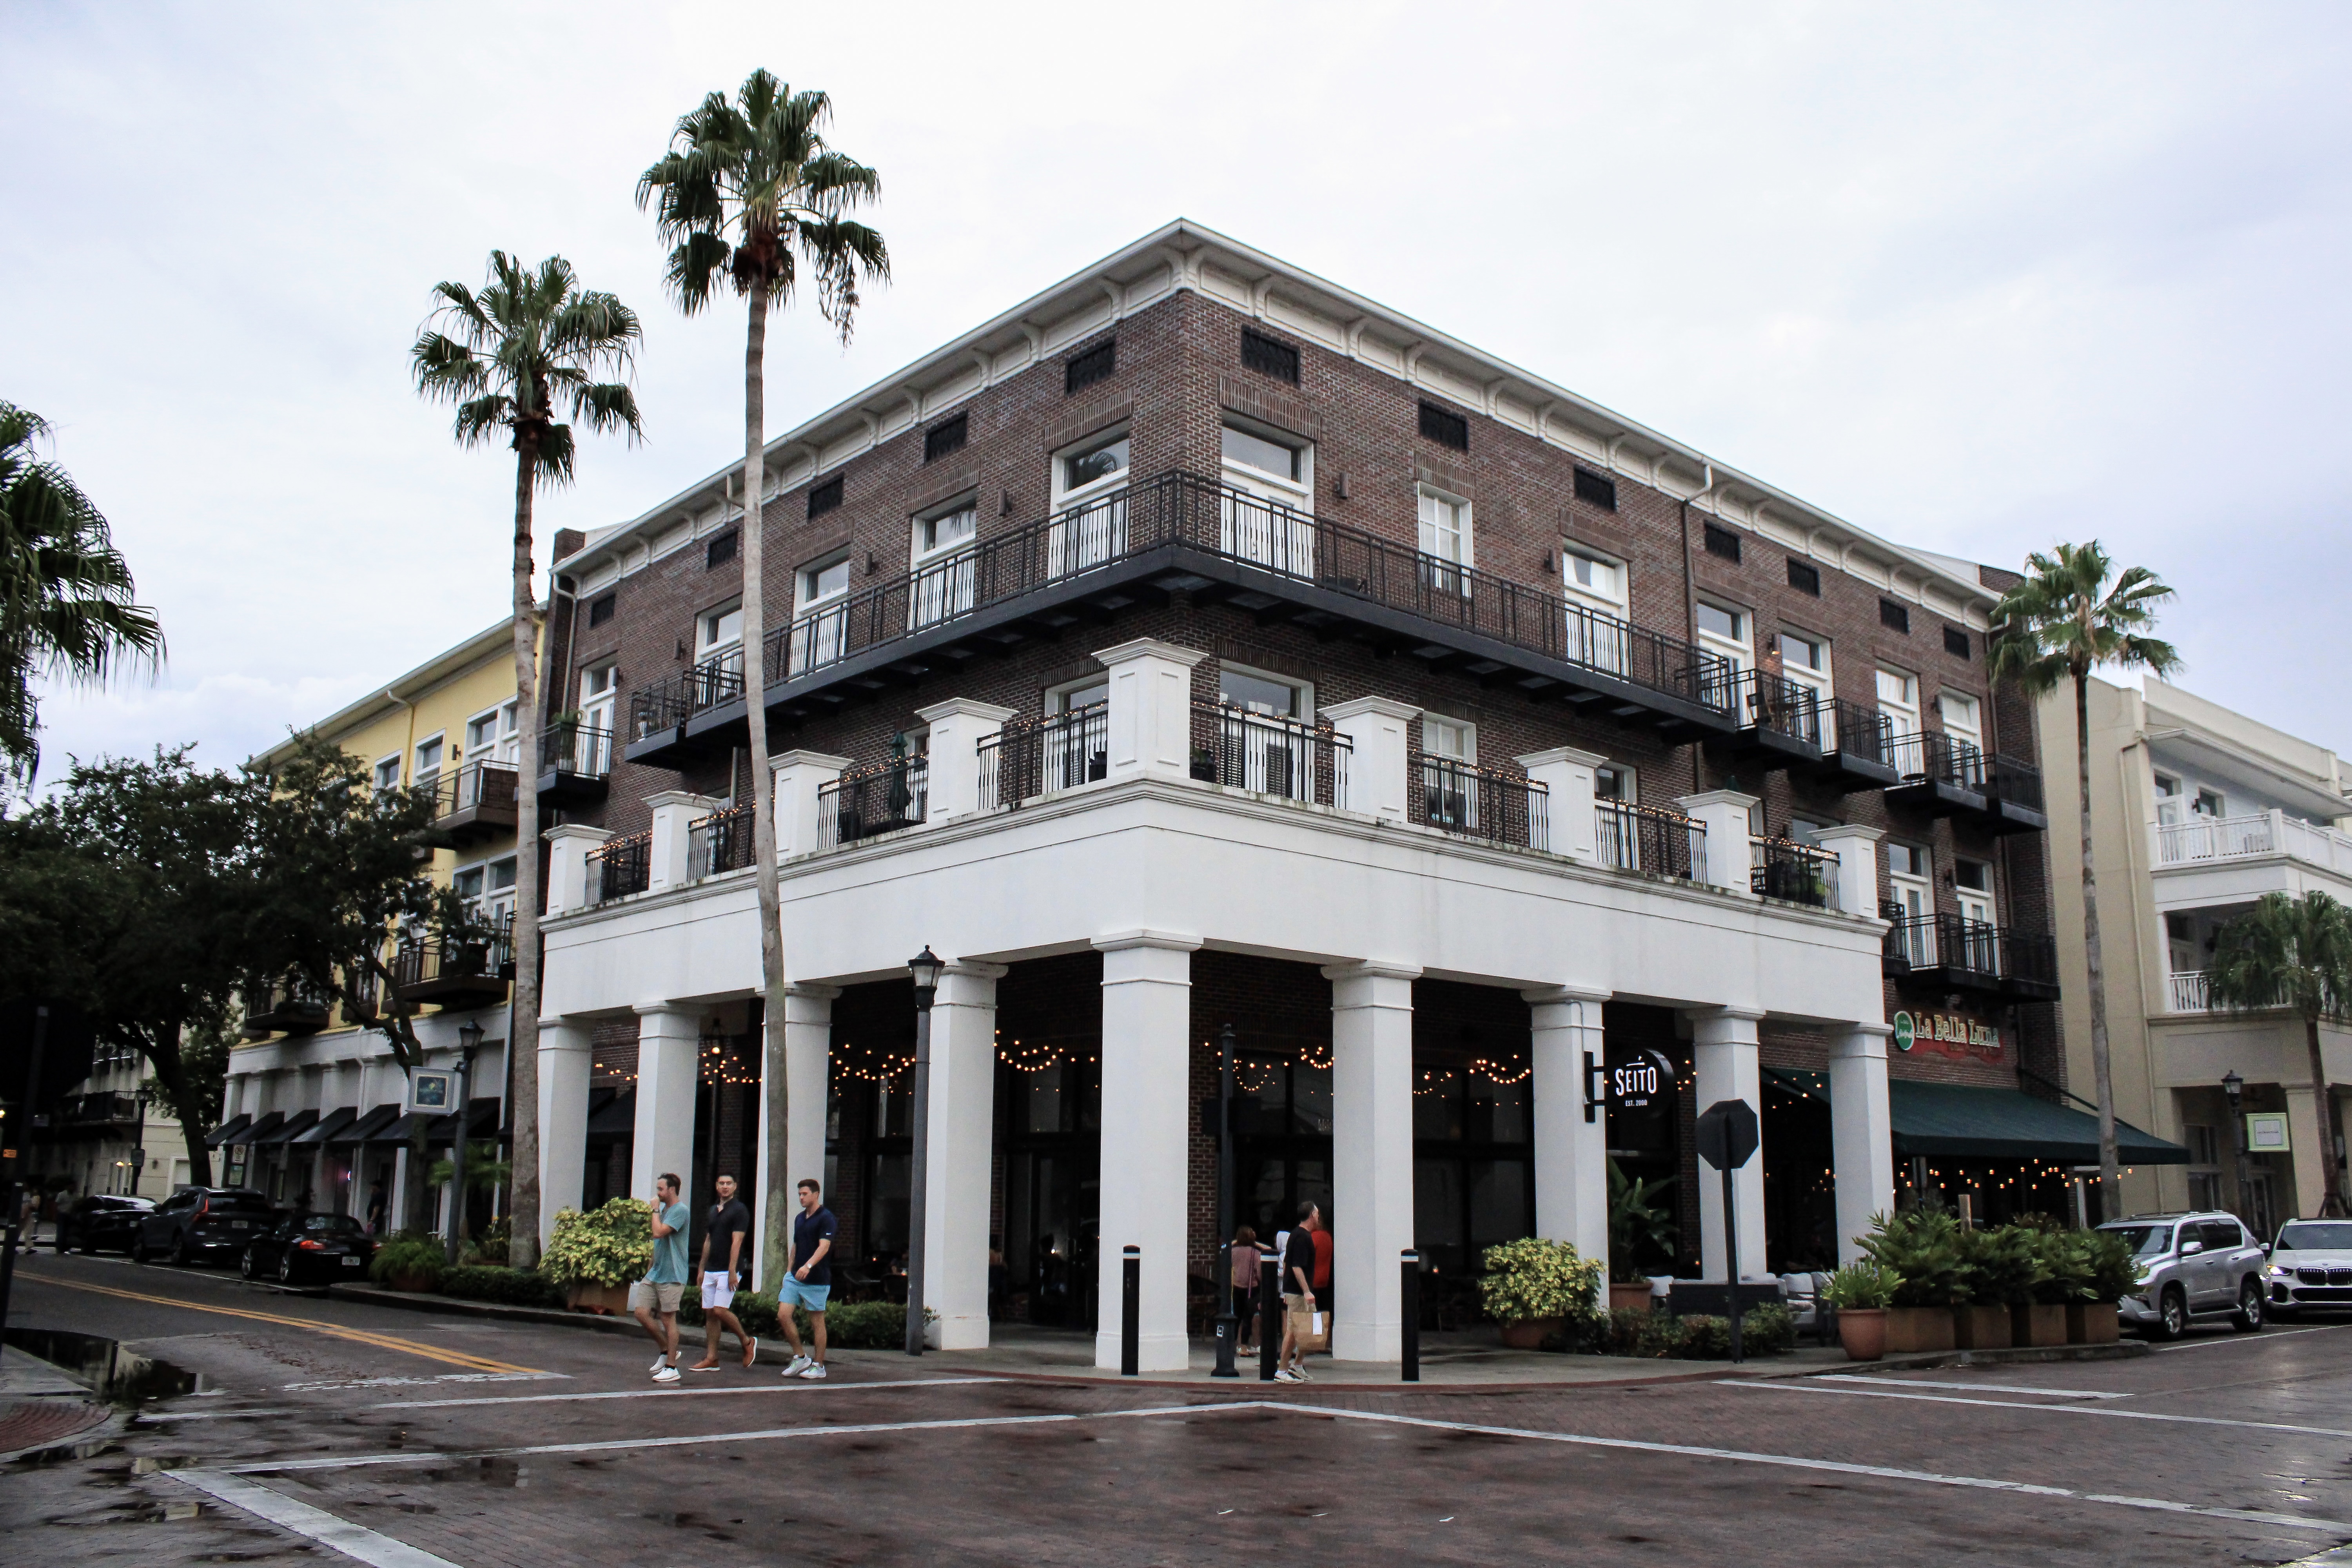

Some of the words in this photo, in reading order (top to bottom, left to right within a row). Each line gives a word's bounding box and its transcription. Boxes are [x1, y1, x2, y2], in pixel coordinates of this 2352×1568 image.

[1915, 1012, 1932, 1039] La
[1934, 1014, 1967, 1044] Bella
[1615, 1066, 1657, 1096] SEITO
